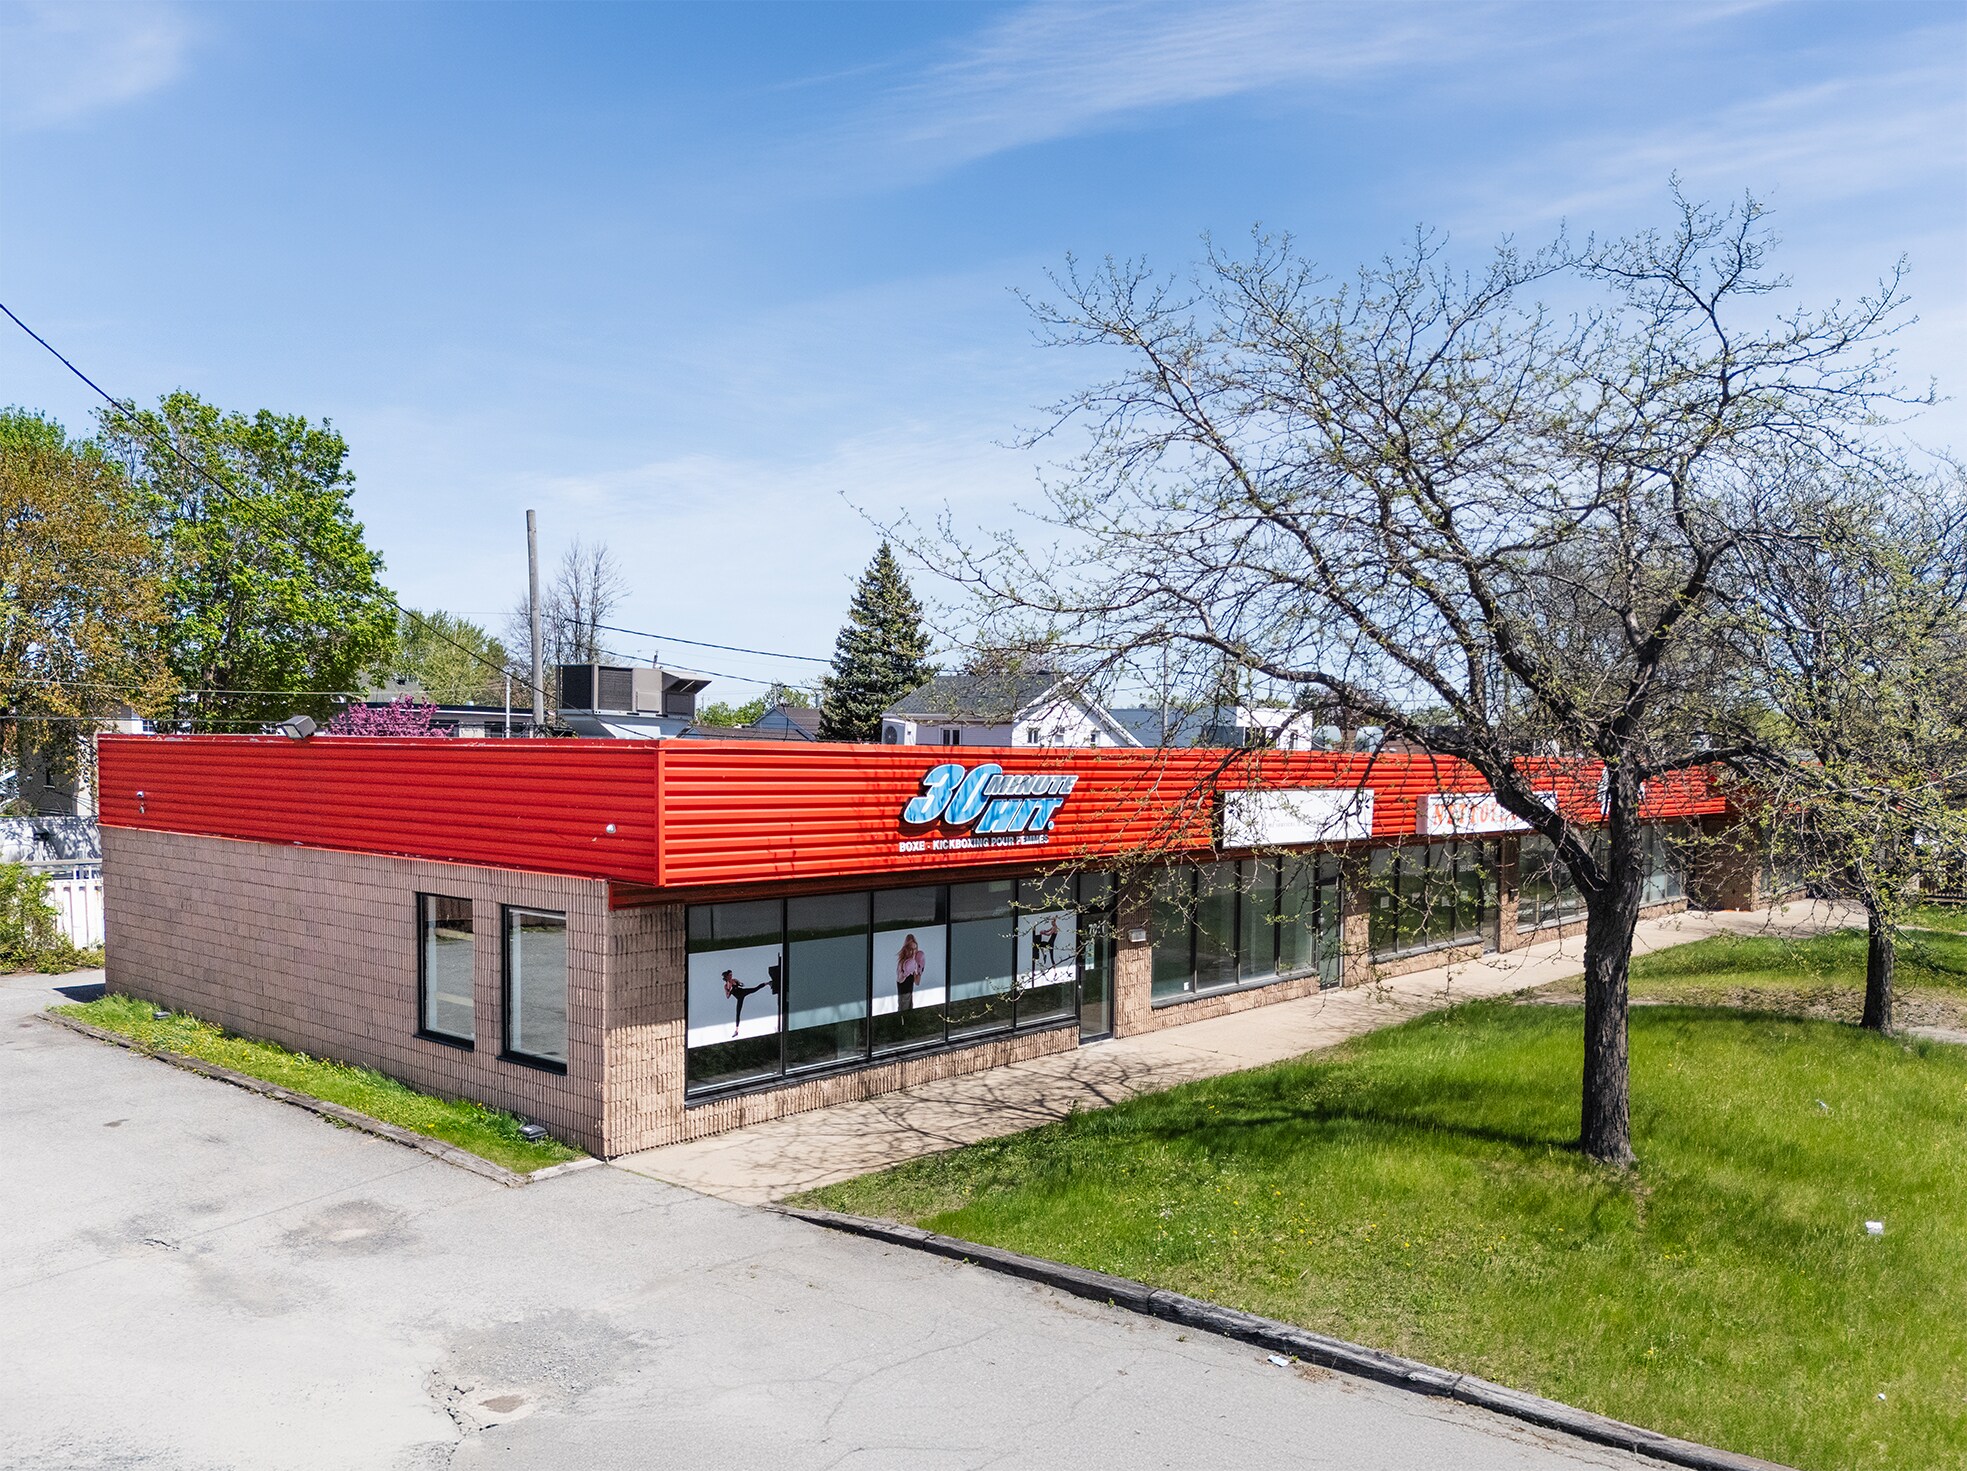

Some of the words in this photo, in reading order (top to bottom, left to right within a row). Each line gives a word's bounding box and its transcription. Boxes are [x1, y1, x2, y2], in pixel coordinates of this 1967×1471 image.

[903, 763, 1003, 825] 30
[983, 775, 1079, 796] MINUTE
[899, 841, 925, 852] BOXE
[932, 838, 989, 850] KICKBOXING
[991, 836, 1015, 847] POUR
[1015, 834, 1049, 845] FEMMES
